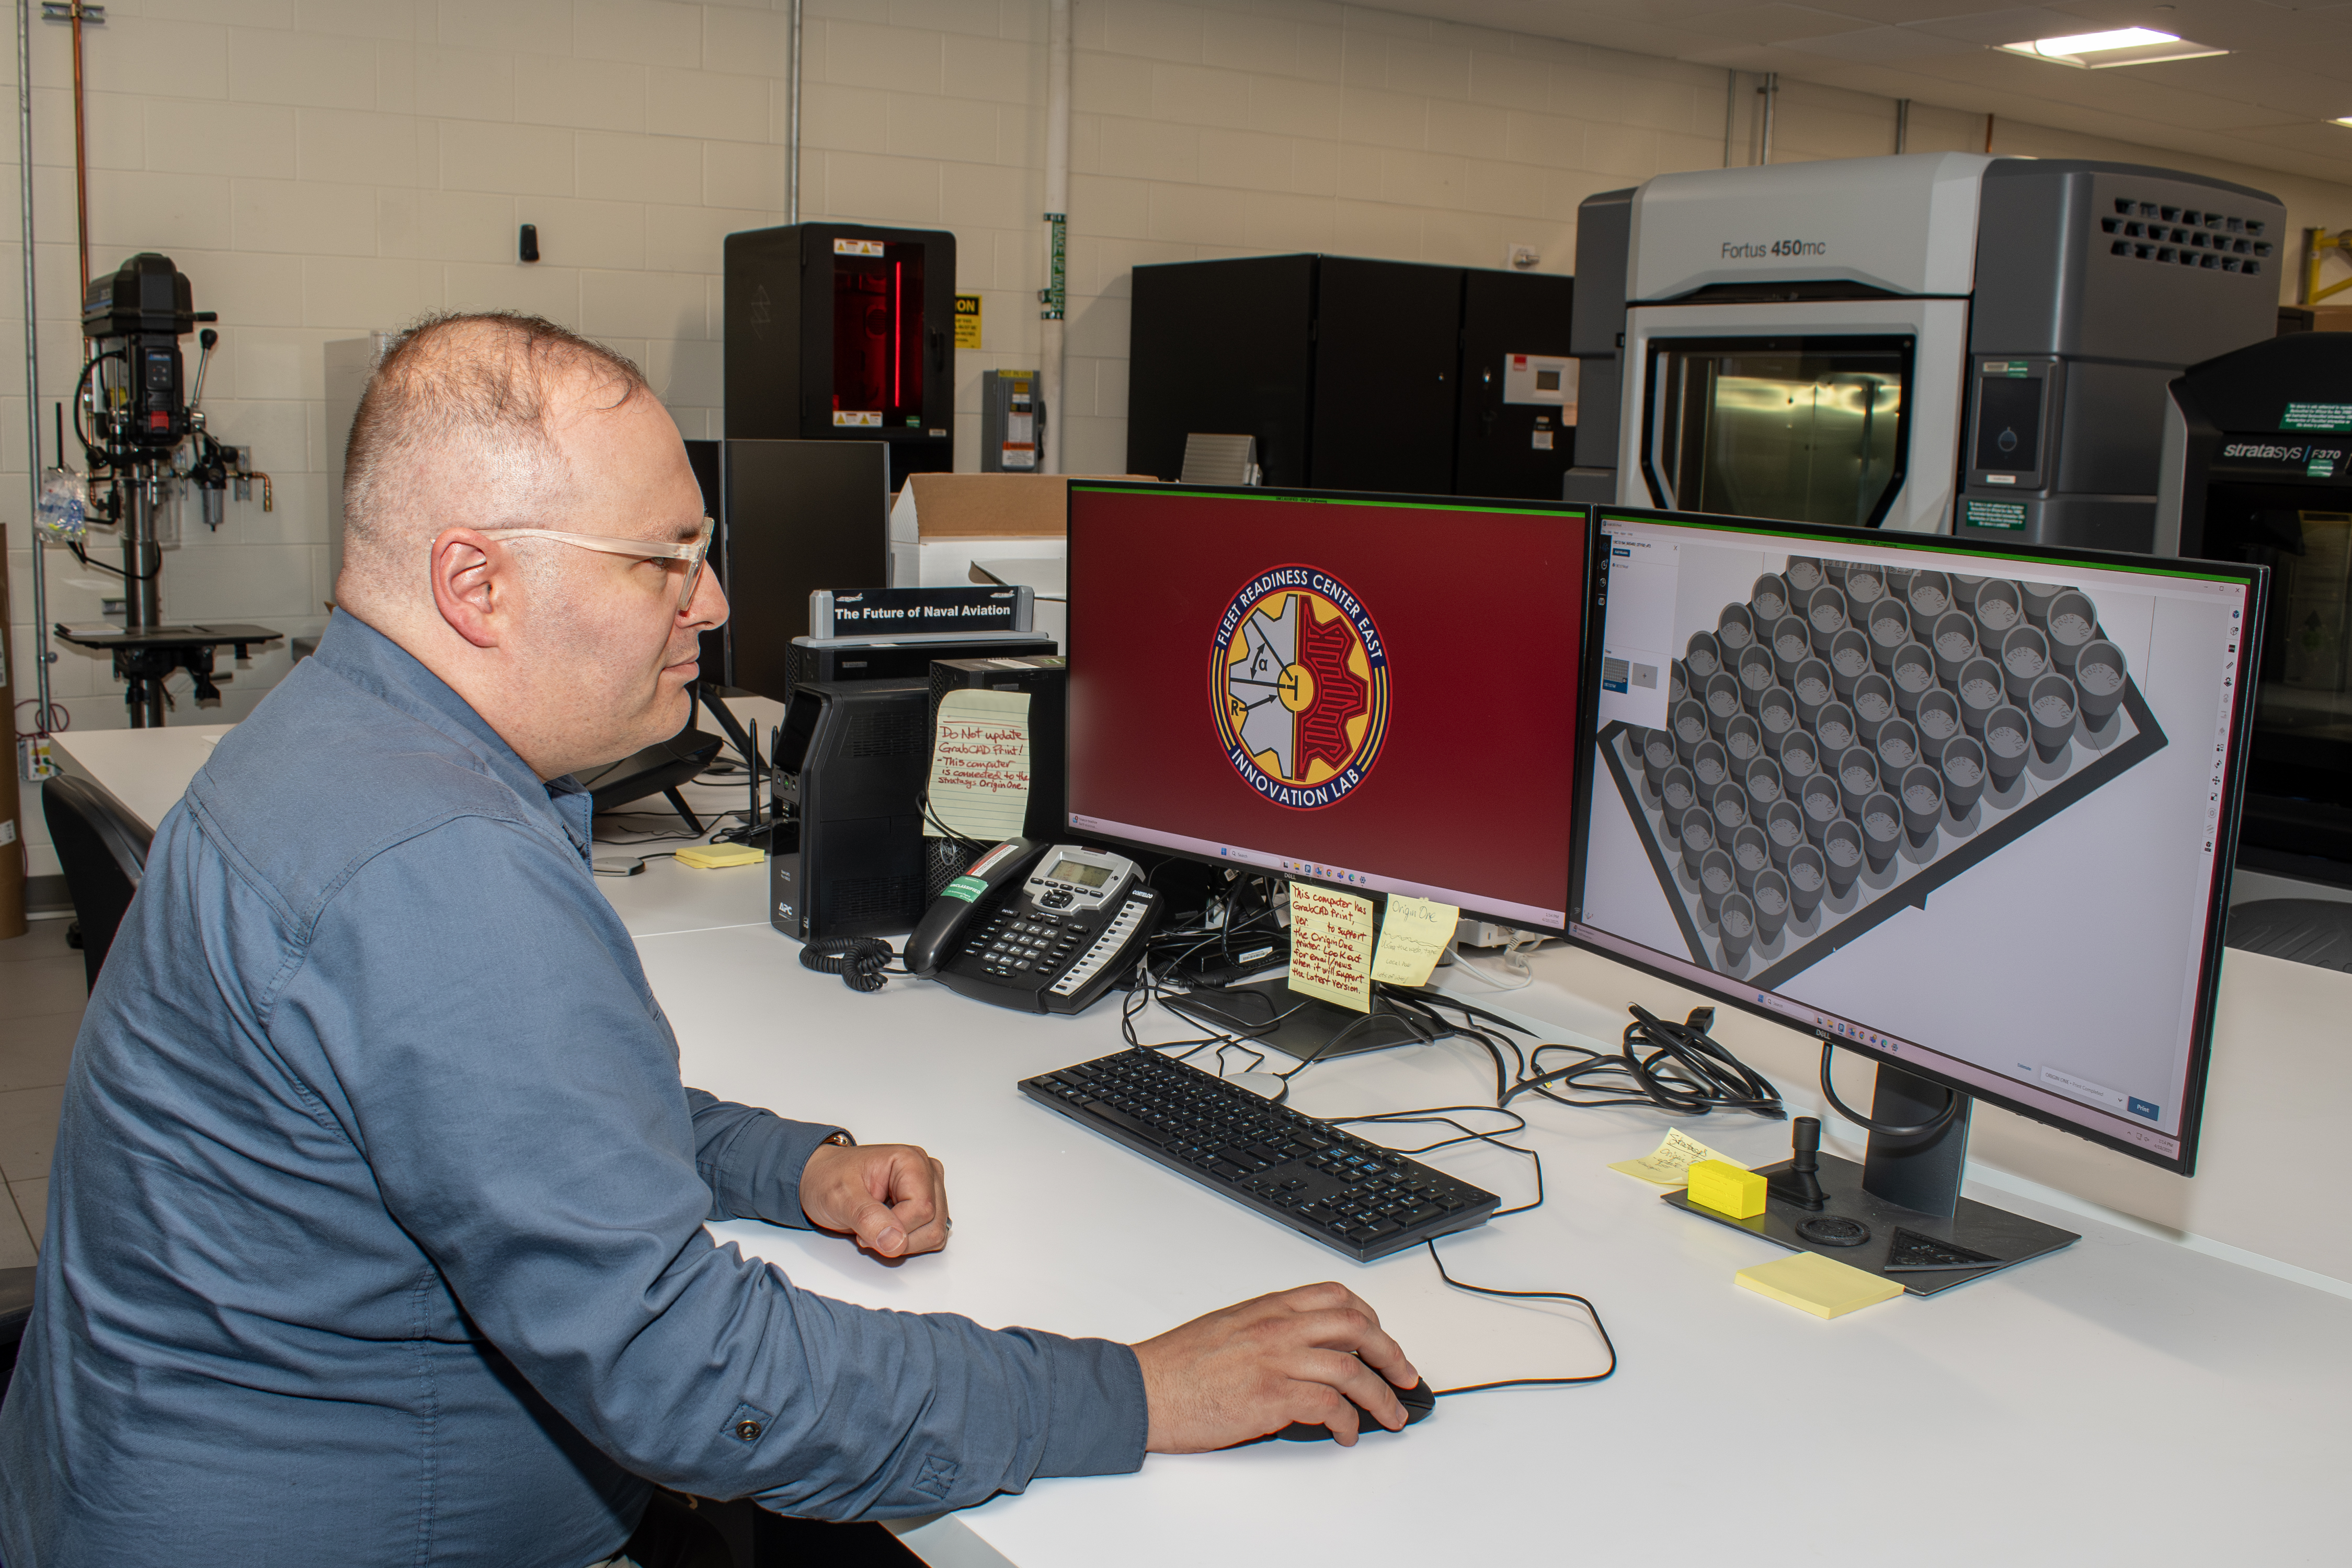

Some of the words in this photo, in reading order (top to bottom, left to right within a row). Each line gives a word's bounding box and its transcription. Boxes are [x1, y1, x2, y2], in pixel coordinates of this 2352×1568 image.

[1721, 242, 1767, 259] Fortus
[1771, 239, 1826, 256] 450mc
[2223, 443, 2302, 462] stratasys
[2311, 449, 2342, 459] F370
[835, 609, 859, 620] The
[863, 608, 904, 619] Future
[908, 606, 920, 617] of
[924, 605, 958, 617] Naval
[962, 605, 1011, 616] Aviation
[1217, 603, 1241, 646] FLEET
[1239, 569, 1308, 608] READINESS
[1313, 574, 1361, 619] CENTER
[1357, 617, 1383, 658] EAST
[1230, 700, 1239, 716] R
[939, 726, 958, 739] Do
[962, 727, 983, 739] Not
[986, 729, 1029, 743] update
[939, 742, 991, 755] GrabCAD
[966, 760, 1017, 770] computer
[942, 767, 951, 776] is
[953, 771, 1002, 780] connected
[1004, 771, 1014, 780] to
[1017, 771, 1030, 781] the
[1231, 749, 1329, 806] INNOVATION
[1331, 768, 1359, 798] LAB
[979, 780, 1006, 792] Origin
[950, 884, 981, 894] UNCLASSIFIED
[1132, 890, 1154, 899] CORTELCO
[1292, 885, 1310, 899] This
[1313, 894, 1352, 909] computer
[1354, 901, 1366, 915] has
[779, 902, 792, 915] APC
[1293, 901, 1329, 915] GrabCAD
[1392, 900, 1417, 922] Origin
[1418, 906, 1439, 923] One
[1327, 922, 1335, 933] to
[1338, 927, 1367, 941] support
[1294, 927, 1308, 940] the
[1311, 932, 1338, 948] Origin
[1338, 938, 1354, 952] One
[1294, 948, 1308, 959] for
[1292, 967, 1305, 978] the
[1293, 958, 1311, 969] when
[1313, 963, 1321, 972] it
[1322, 966, 1335, 976] will
[1335, 970, 1365, 984] support
[1816, 1028, 1831, 1039] DELL
[2045, 1072, 2059, 1082] ORIGIN
[2060, 1076, 2070, 1085] ONE
[2072, 1081, 2082, 1090] Print
[2082, 1085, 2104, 1097] Completed
[2136, 1103, 2150, 1114] Print
